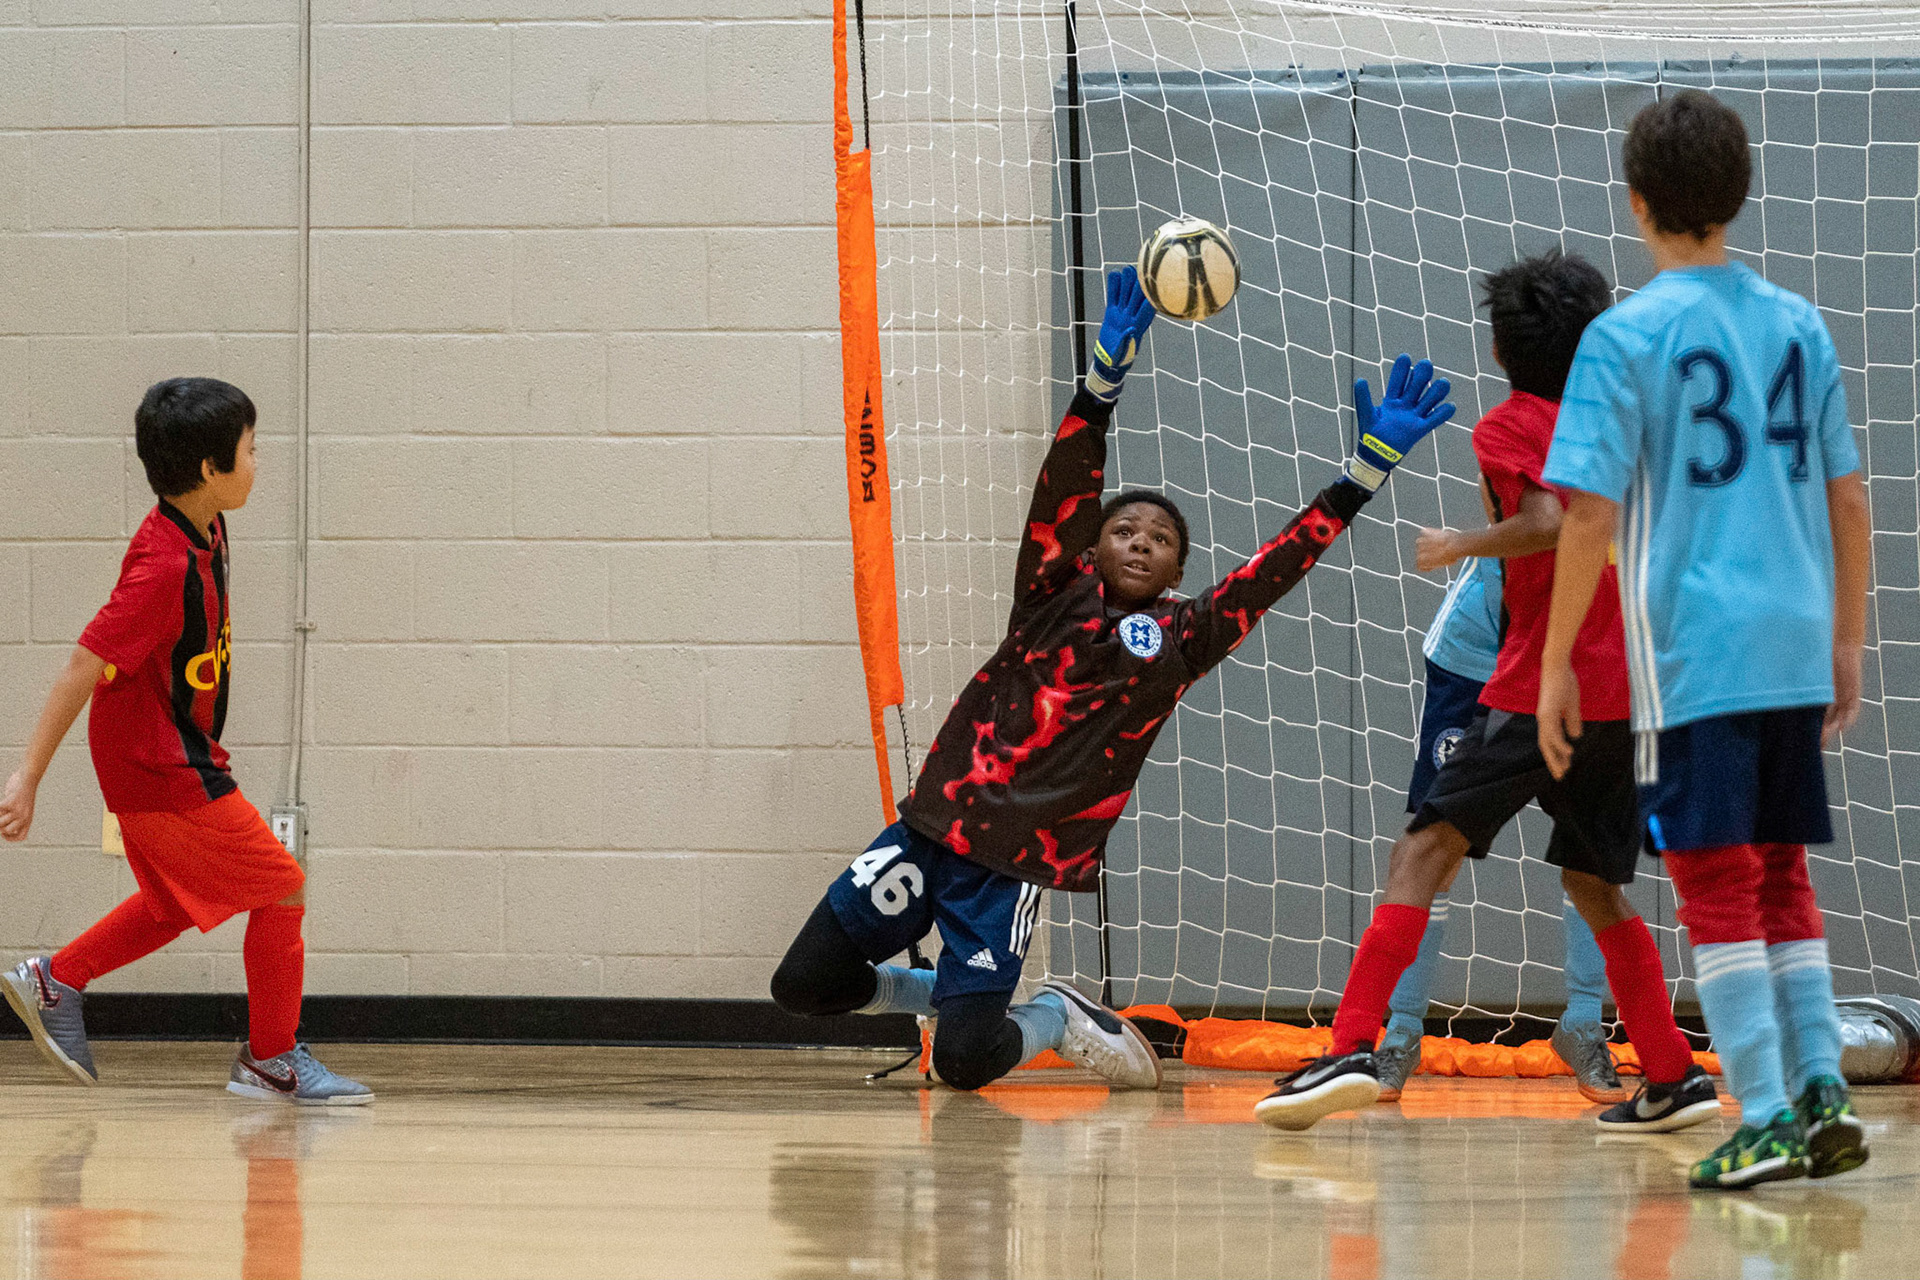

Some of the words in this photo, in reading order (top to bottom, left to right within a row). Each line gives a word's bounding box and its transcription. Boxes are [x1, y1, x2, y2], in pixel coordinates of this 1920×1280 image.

[1674, 338, 1810, 488] 34
[850, 844, 924, 916] 46
[967, 957, 998, 972] adidas
